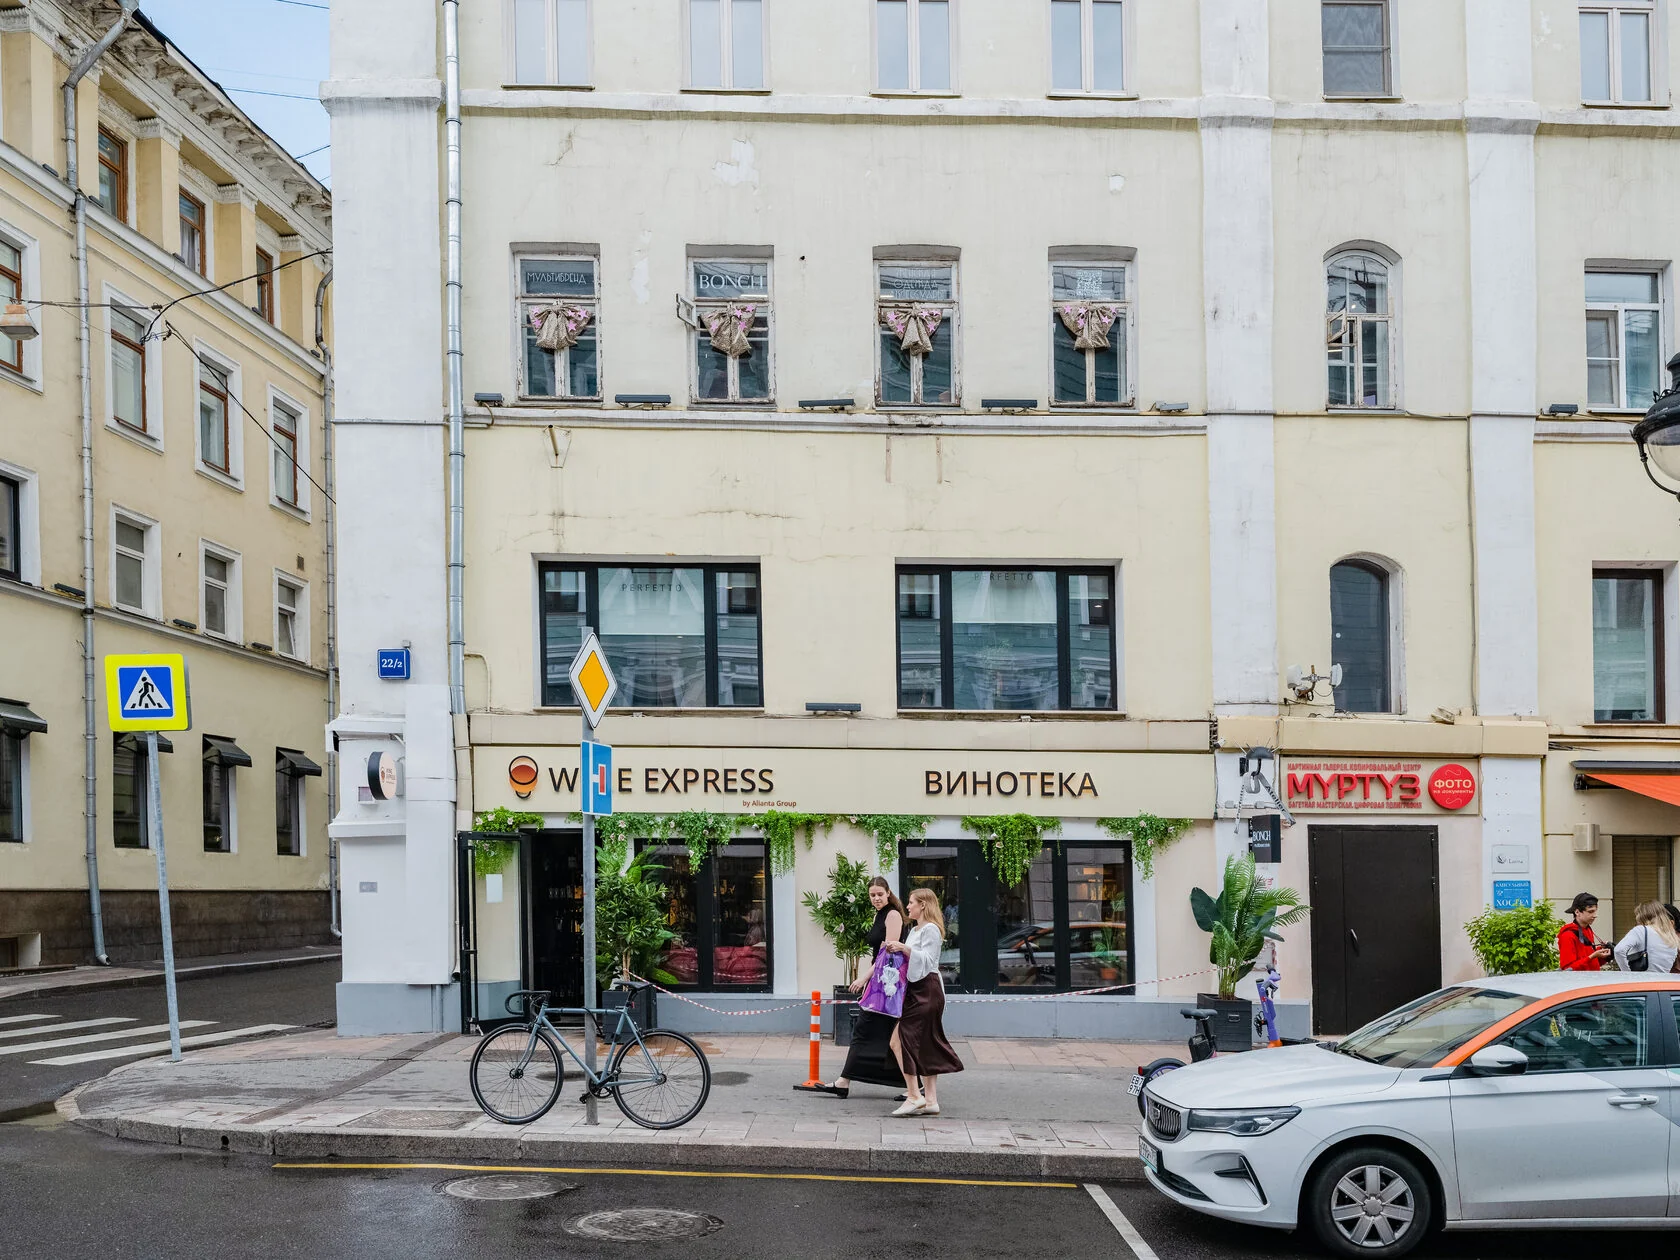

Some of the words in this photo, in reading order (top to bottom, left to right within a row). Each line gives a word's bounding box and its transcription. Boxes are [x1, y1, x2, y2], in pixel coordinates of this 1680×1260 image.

[699, 274, 763, 290] BONCH
[973, 573, 1035, 581] PERFETTO
[620, 583, 682, 592] PERFETTO
[381, 658, 403, 668] 22/2
[548, 767, 632, 793] WE
[644, 768, 775, 793] EXPRESS
[925, 770, 1098, 797] ВИНОТЕКА
[1434, 778, 1472, 789] ФОТО
[1287, 773, 1421, 800] МУРТУЗ
[742, 800, 751, 808] by
[776, 800, 797, 809] Group
[1265, 785, 1286, 813] Atelier
[1252, 830, 1271, 842] BONCH
